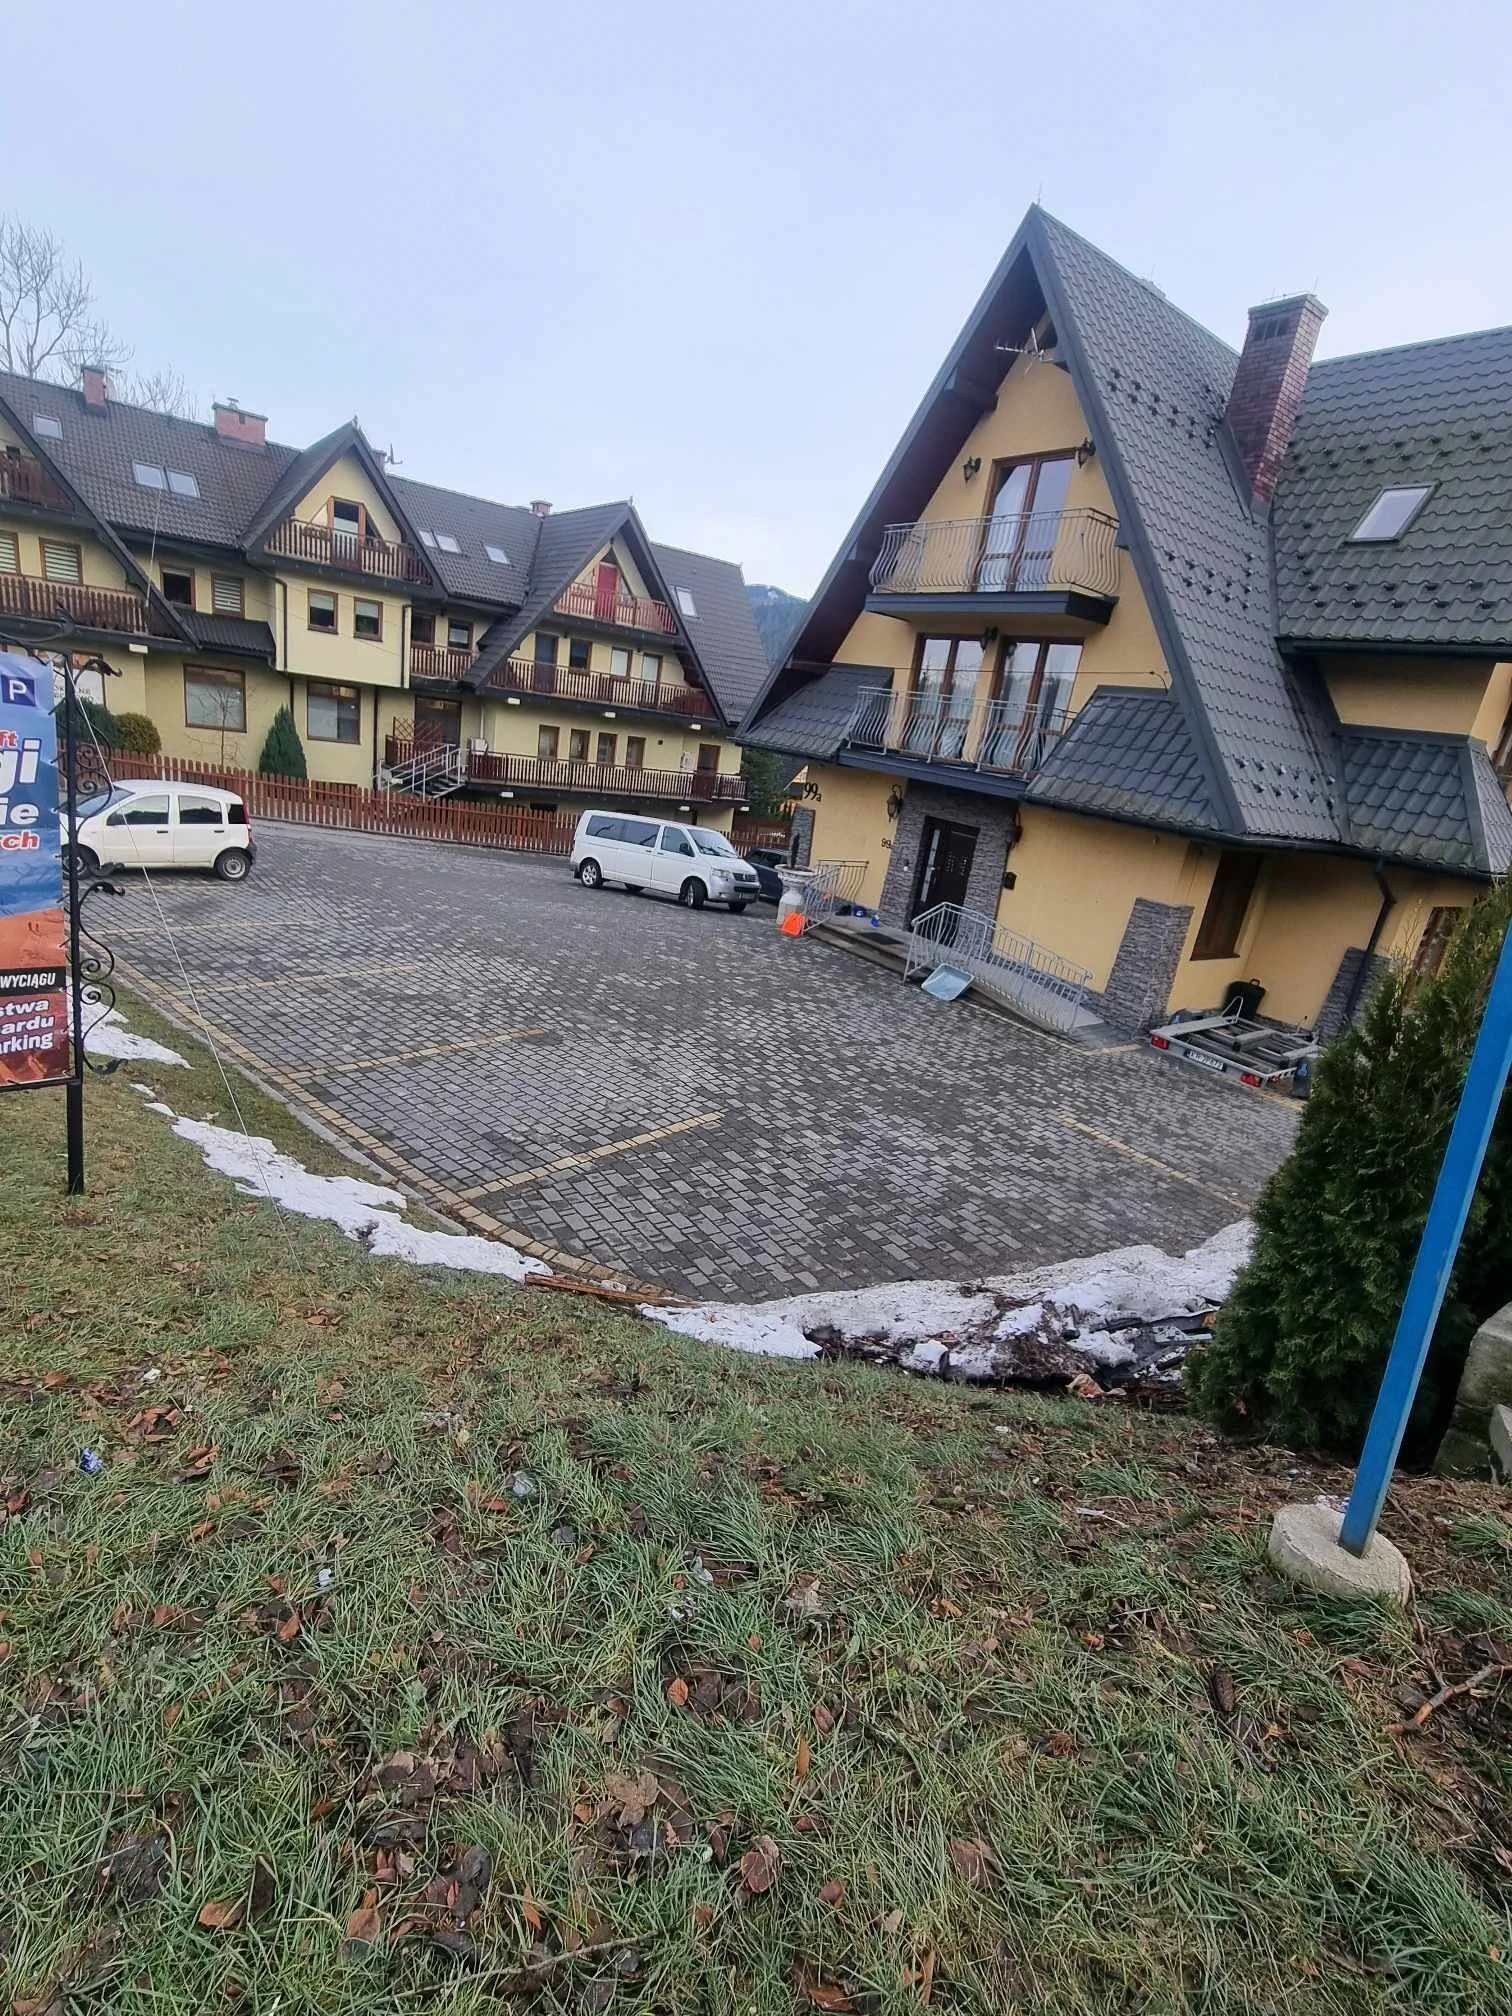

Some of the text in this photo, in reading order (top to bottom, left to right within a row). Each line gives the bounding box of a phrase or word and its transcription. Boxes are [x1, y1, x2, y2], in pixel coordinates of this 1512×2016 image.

[803, 782, 821, 802] 99a
[0, 972, 56, 989] WYCIĄGU
[0, 1032, 53, 1054] rking
